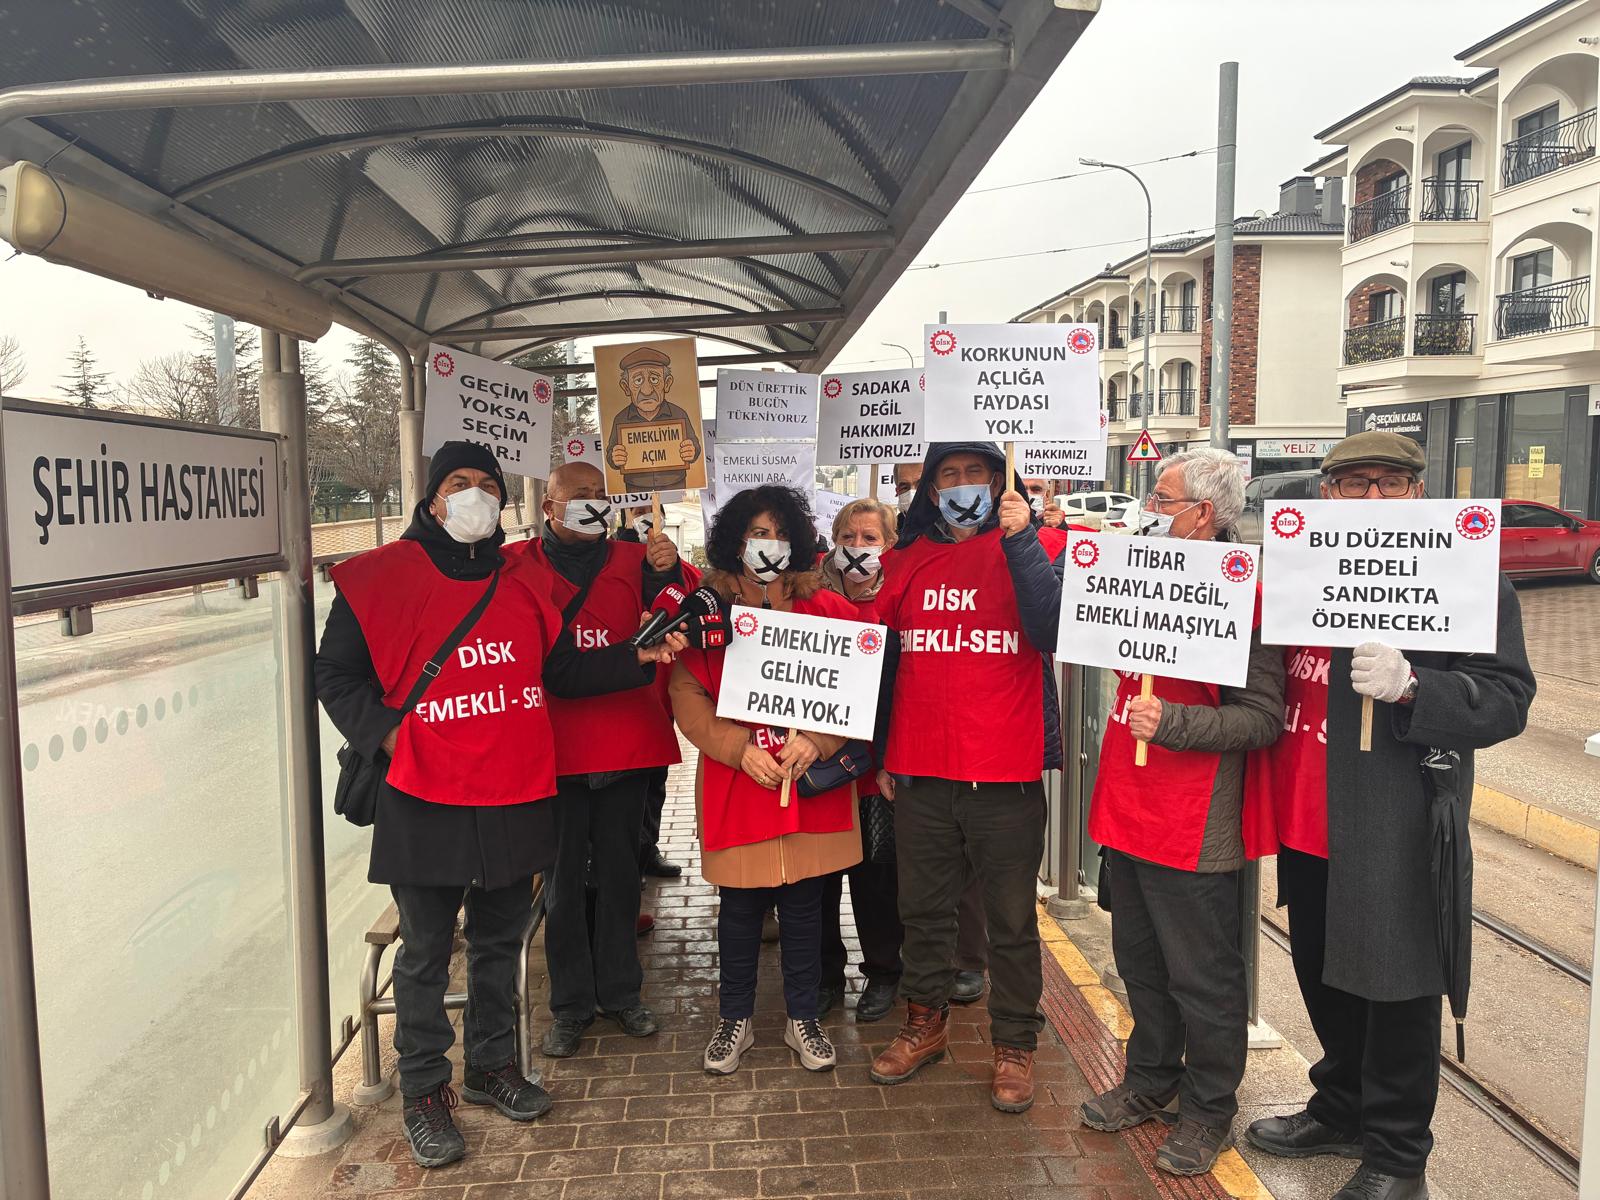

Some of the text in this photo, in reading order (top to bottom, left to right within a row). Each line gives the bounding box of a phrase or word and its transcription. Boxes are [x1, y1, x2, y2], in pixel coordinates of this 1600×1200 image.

[961, 346, 1066, 362] KORKUNUN
[730, 380, 808, 395] DÜN ÜRETTİK
[851, 379, 911, 396] SADAKA
[977, 367, 1045, 389] AÇLIĞA
[460, 374, 529, 404] GEÇİM
[459, 394, 537, 427] YOKSA,
[748, 396, 789, 409] BUGÜN
[860, 398, 902, 417] DEĞİL
[973, 394, 1049, 410] FAYDASI
[727, 409, 808, 424] TÜKENİYORUZ
[1376, 411, 1423, 426] SEÇKİN KARA
[462, 417, 528, 444] SEÇİM
[627, 426, 680, 445] EMEKLİYİM
[840, 422, 916, 439] HAKKIMIZI
[985, 419, 1034, 435] YOK.!
[839, 442, 921, 460] İSTİYORUZ.!
[1025, 449, 1087, 460] HAKKIMIZI
[1283, 441, 1316, 454] YELİZ
[641, 450, 667, 466] AÇIM
[723, 454, 760, 466] EMEKLİ
[761, 455, 798, 465] SUSMA
[723, 473, 764, 483] HAKKINI
[1024, 462, 1092, 476] İSTİYORUZ.!
[33, 443, 265, 545] ŞEHİR HASTANESİ
[1278, 517, 1298, 527] DİSK
[1309, 528, 1453, 549] BU DÜZENİN
[1077, 548, 1094, 557] DİSK
[1127, 544, 1186, 571] İTİBAR
[1338, 555, 1418, 577] BEDELİ
[922, 583, 978, 611] DİSK
[1085, 575, 1229, 610] SARAYLA DEĞİL,
[1322, 585, 1440, 605] SANDIKTA
[1075, 604, 1238, 640] EMEKLİ MAAŞIYLA
[1311, 608, 1450, 633] ÖDENECEK.!
[576, 624, 610, 648] İSK
[760, 625, 852, 657] EMEKLİYE
[457, 637, 516, 669] DİSK
[1118, 638, 1178, 665] OLUR.!
[760, 659, 840, 690] GELİNCE
[415, 684, 506, 723] EMEKLİ
[747, 691, 851, 727] PARA YOK.!
